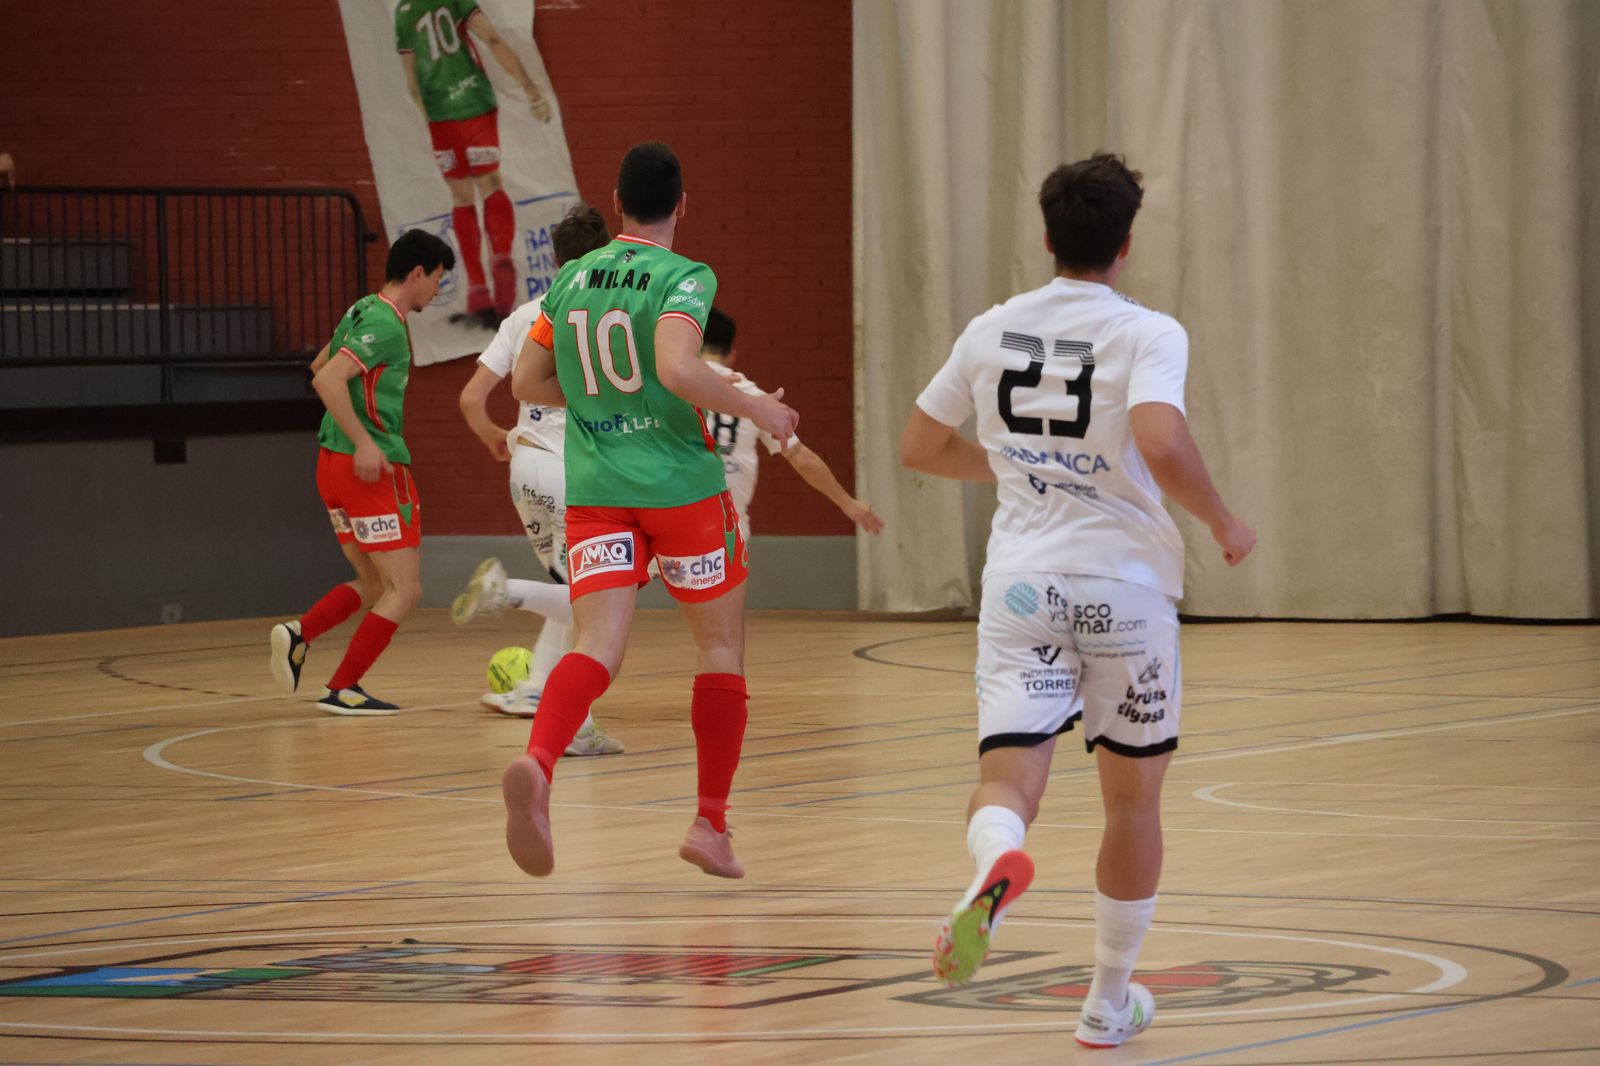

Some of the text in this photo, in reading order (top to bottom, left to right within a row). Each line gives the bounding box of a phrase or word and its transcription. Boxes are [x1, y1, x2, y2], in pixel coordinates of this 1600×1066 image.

[416, 6, 460, 61] 10
[588, 268, 651, 291] MILAR
[567, 308, 645, 397] 10
[998, 331, 1095, 440] 23
[371, 517, 397, 533] chc
[575, 542, 628, 576] AMAQ
[689, 555, 722, 576] chc
